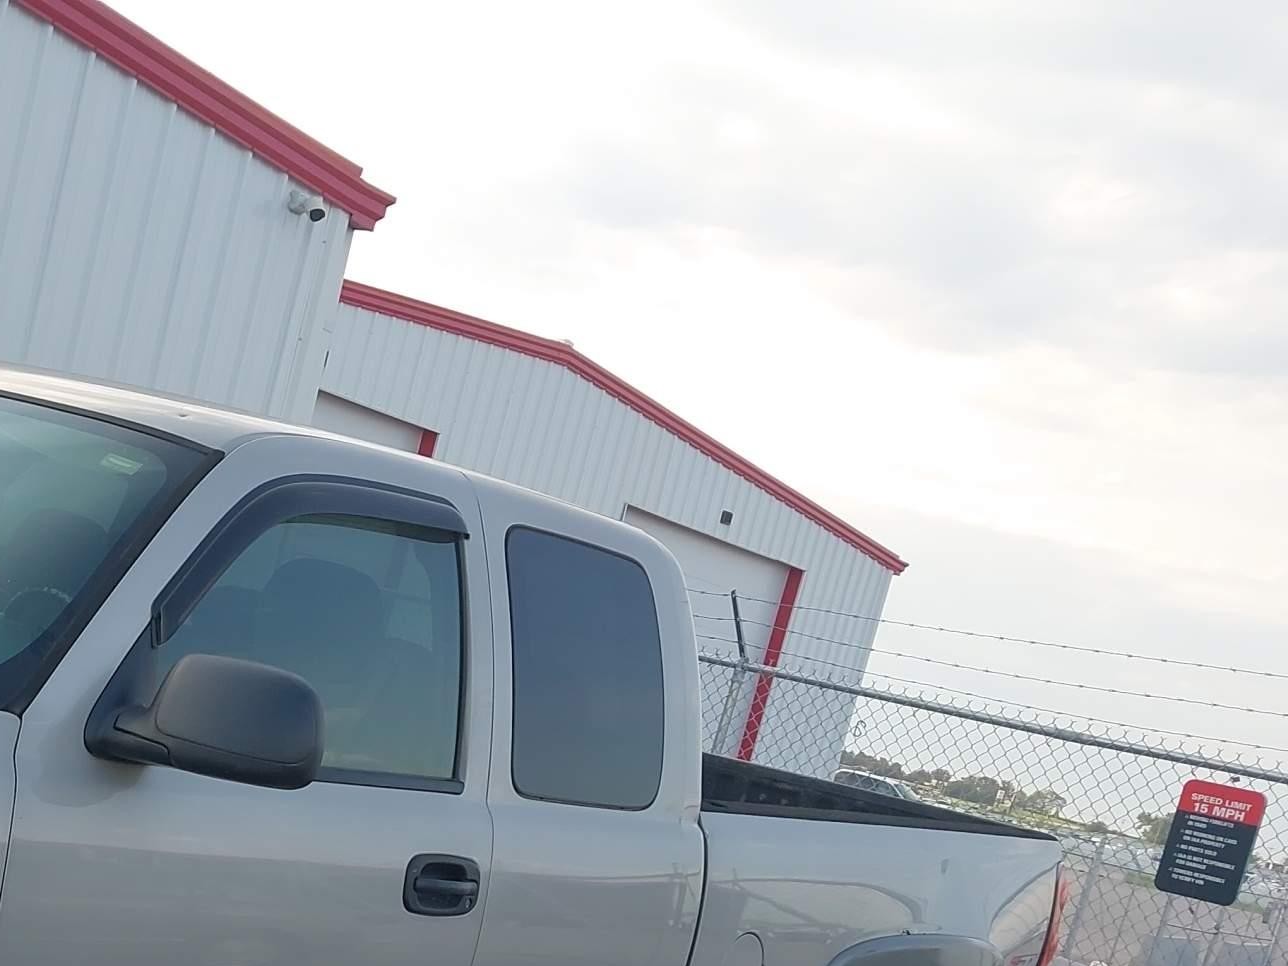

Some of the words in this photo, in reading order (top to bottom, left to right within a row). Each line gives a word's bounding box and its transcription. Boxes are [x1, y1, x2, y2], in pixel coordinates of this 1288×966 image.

[1191, 792, 1223, 806] SPEED
[1225, 800, 1253, 812] LIMIT
[1193, 802, 1209, 814] 15
[1212, 805, 1246, 822] MPH
